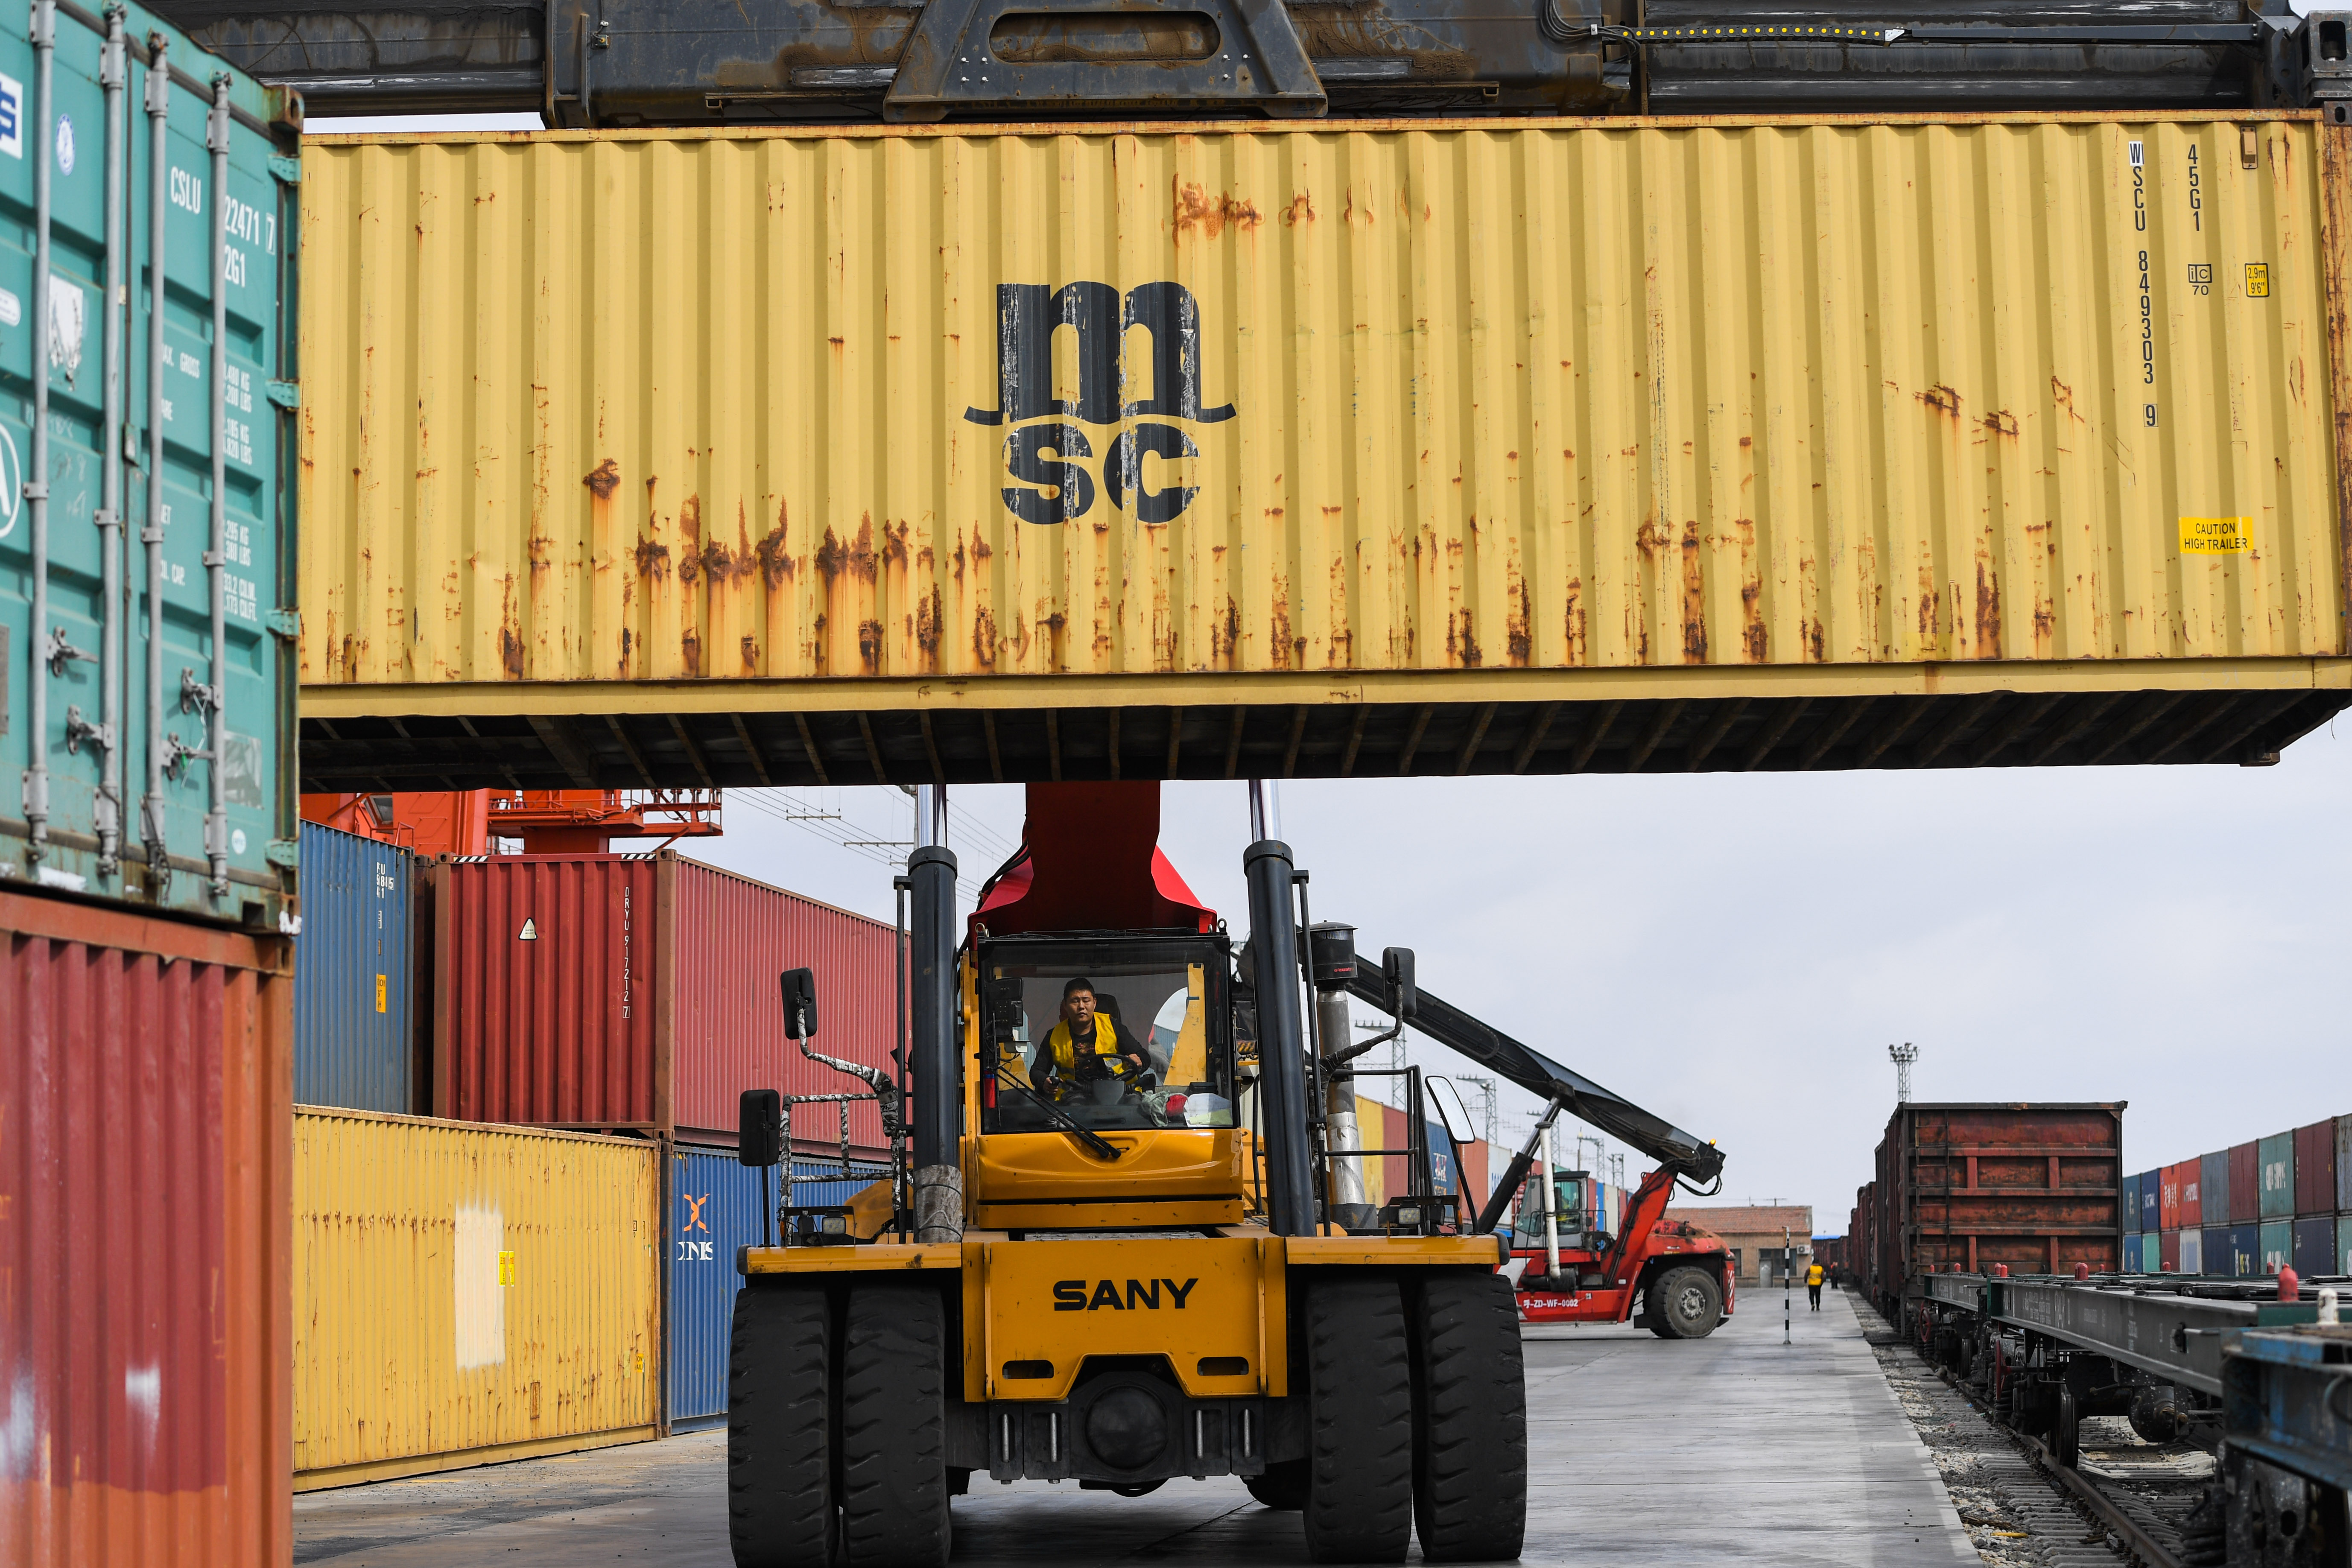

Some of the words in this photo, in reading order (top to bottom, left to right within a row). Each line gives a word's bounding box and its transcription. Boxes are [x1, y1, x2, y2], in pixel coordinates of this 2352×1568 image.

[2188, 144, 2200, 231] 45G1
[170, 166, 201, 214] CSLU
[225, 194, 259, 245] 22471
[266, 215, 275, 251] 7
[225, 244, 245, 287] 2G1
[2192, 285, 2209, 295] 70
[2139, 250, 2153, 384] 849303
[161, 397, 173, 421] ARE
[2145, 405, 2155, 426] 9
[161, 503, 172, 526] ET
[2195, 522, 2236, 535] CAUTION
[2184, 538, 2205, 550] HIGH
[2207, 537, 2248, 550] TRAILER
[1053, 1278, 1199, 1311] SANY
